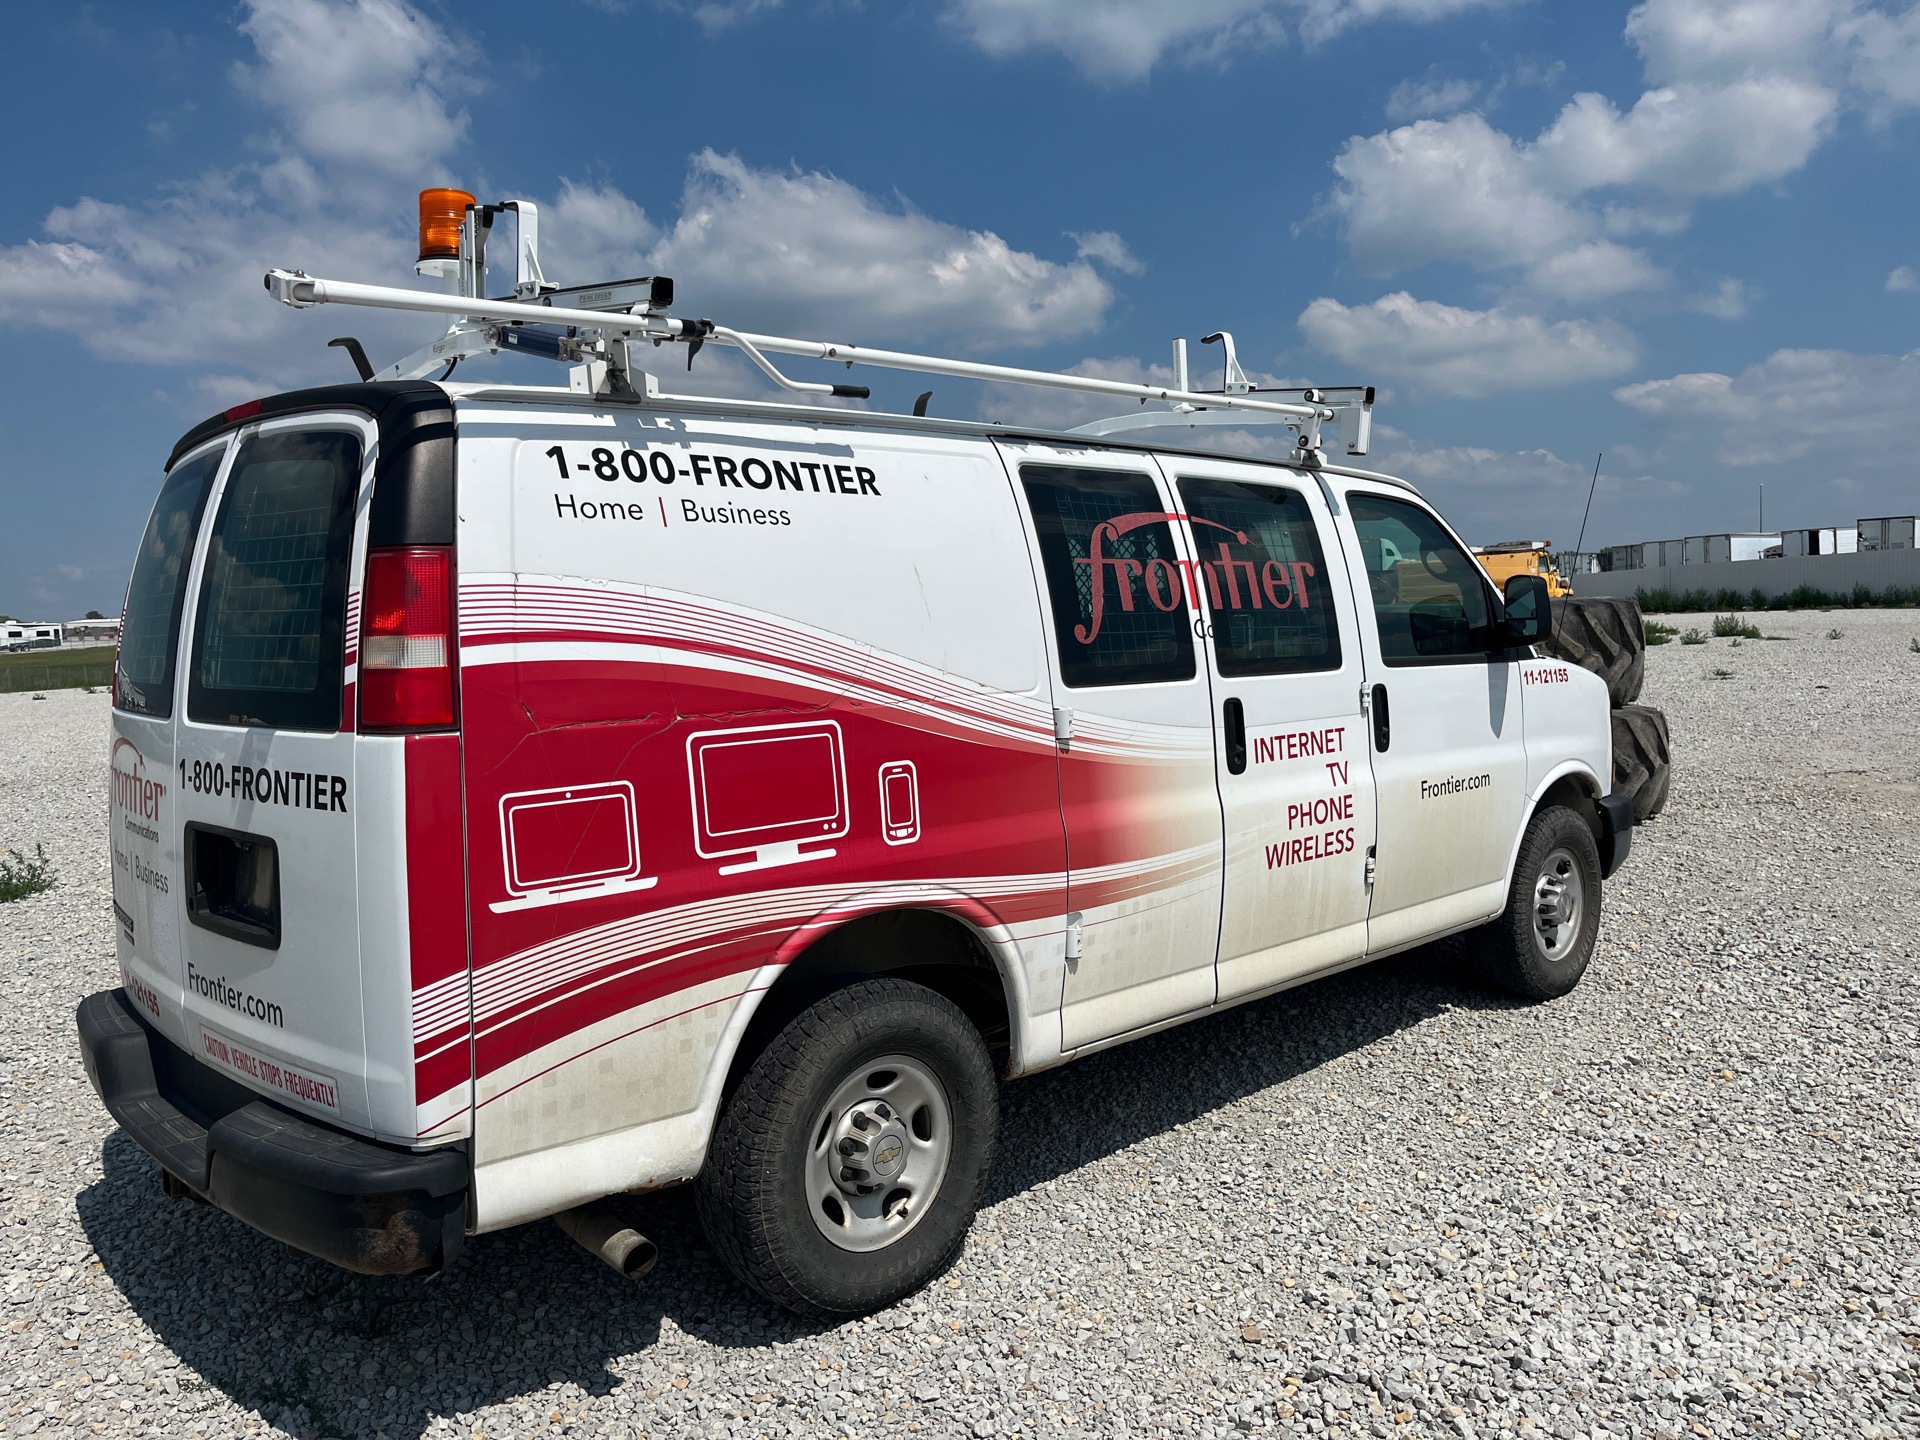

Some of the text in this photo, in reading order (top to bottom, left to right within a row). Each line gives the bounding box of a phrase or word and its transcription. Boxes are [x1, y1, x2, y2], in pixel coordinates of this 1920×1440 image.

[546, 445, 881, 496] 1-800-FRONTIER
[554, 493, 644, 521] Home
[681, 499, 791, 526] Business
[1074, 512, 1314, 644] frontier
[1523, 668, 1569, 685] 11-121155
[1253, 727, 1345, 764] INTERNET
[179, 758, 348, 813] 1-800-FRONTIER
[1326, 761, 1348, 787] TV
[1420, 773, 1491, 800] Frontier.com
[1287, 794, 1354, 830] PHONE
[1265, 827, 1355, 870] WIRELESS
[135, 855, 169, 894] Business
[187, 961, 284, 1028] Frontier.com
[203, 1033, 336, 1108] CAUTION: VEHICLE STOPS FREQUENTLY
